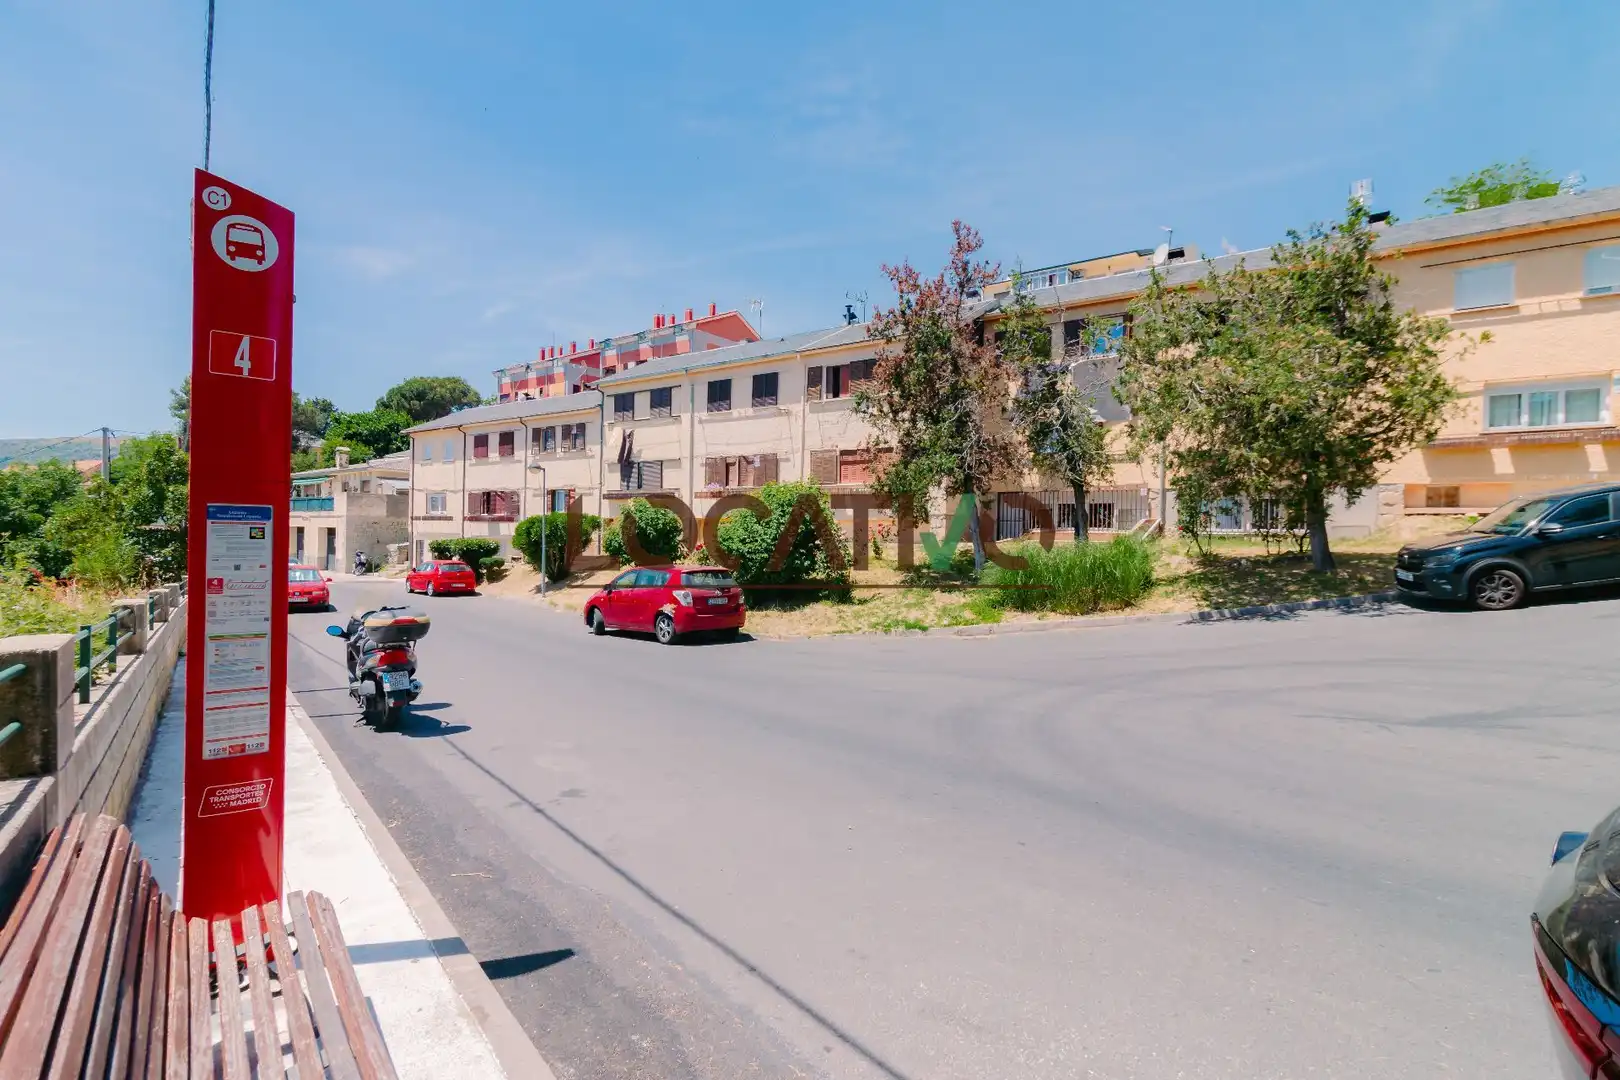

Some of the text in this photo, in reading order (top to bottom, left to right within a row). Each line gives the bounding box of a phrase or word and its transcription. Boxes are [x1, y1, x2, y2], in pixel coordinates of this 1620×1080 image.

[207, 190, 227, 207] C1
[234, 335, 251, 377] 4
[209, 789, 264, 803] TRANSPORTES
[215, 783, 267, 796] CONSORCIO
[229, 796, 262, 807] MADRID
